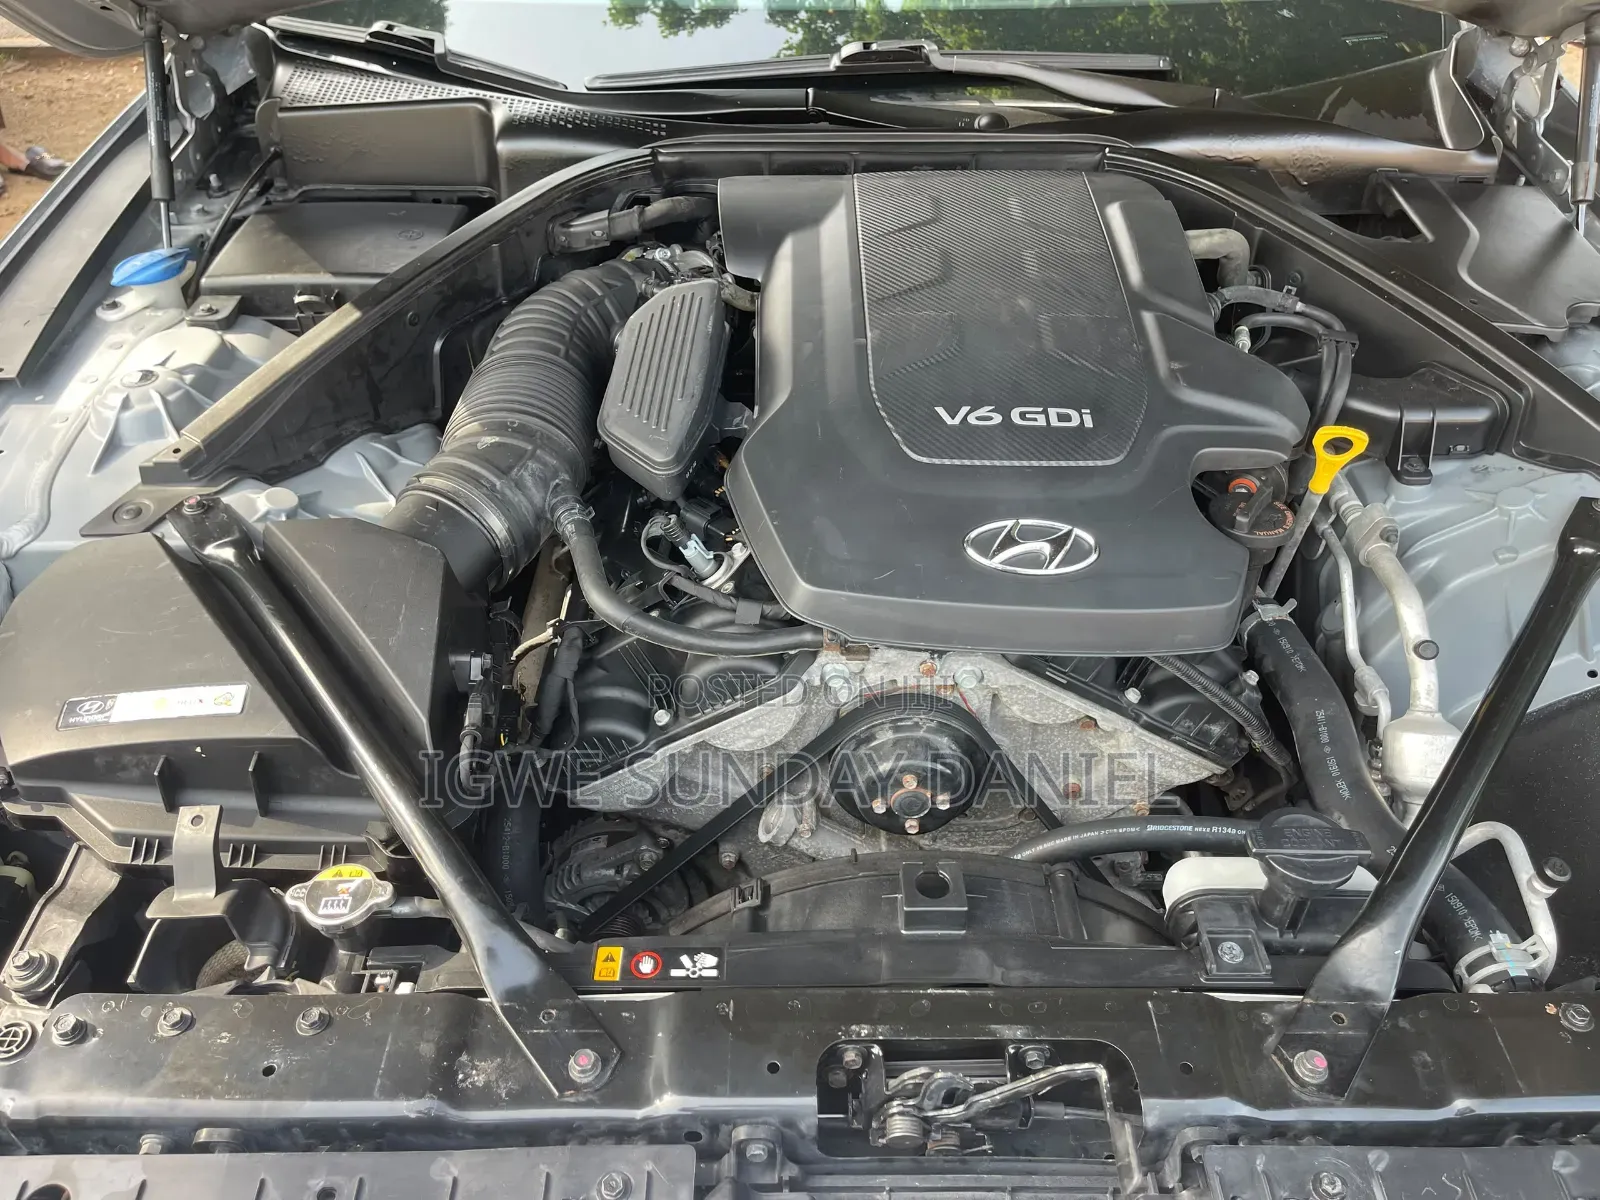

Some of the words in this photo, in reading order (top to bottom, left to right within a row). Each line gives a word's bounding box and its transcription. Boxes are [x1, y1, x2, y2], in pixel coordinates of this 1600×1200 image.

[934, 406, 1002, 425] V6
[1010, 406, 1094, 428] GDi
[1325, 756, 1341, 777] 150910
[1055, 836, 1072, 844] MADE
[1080, 830, 1099, 839] JAPAN
[1146, 824, 1193, 832] BRIDGESTONE
[1211, 826, 1236, 834] R134a
[1444, 892, 1468, 916] 150910
